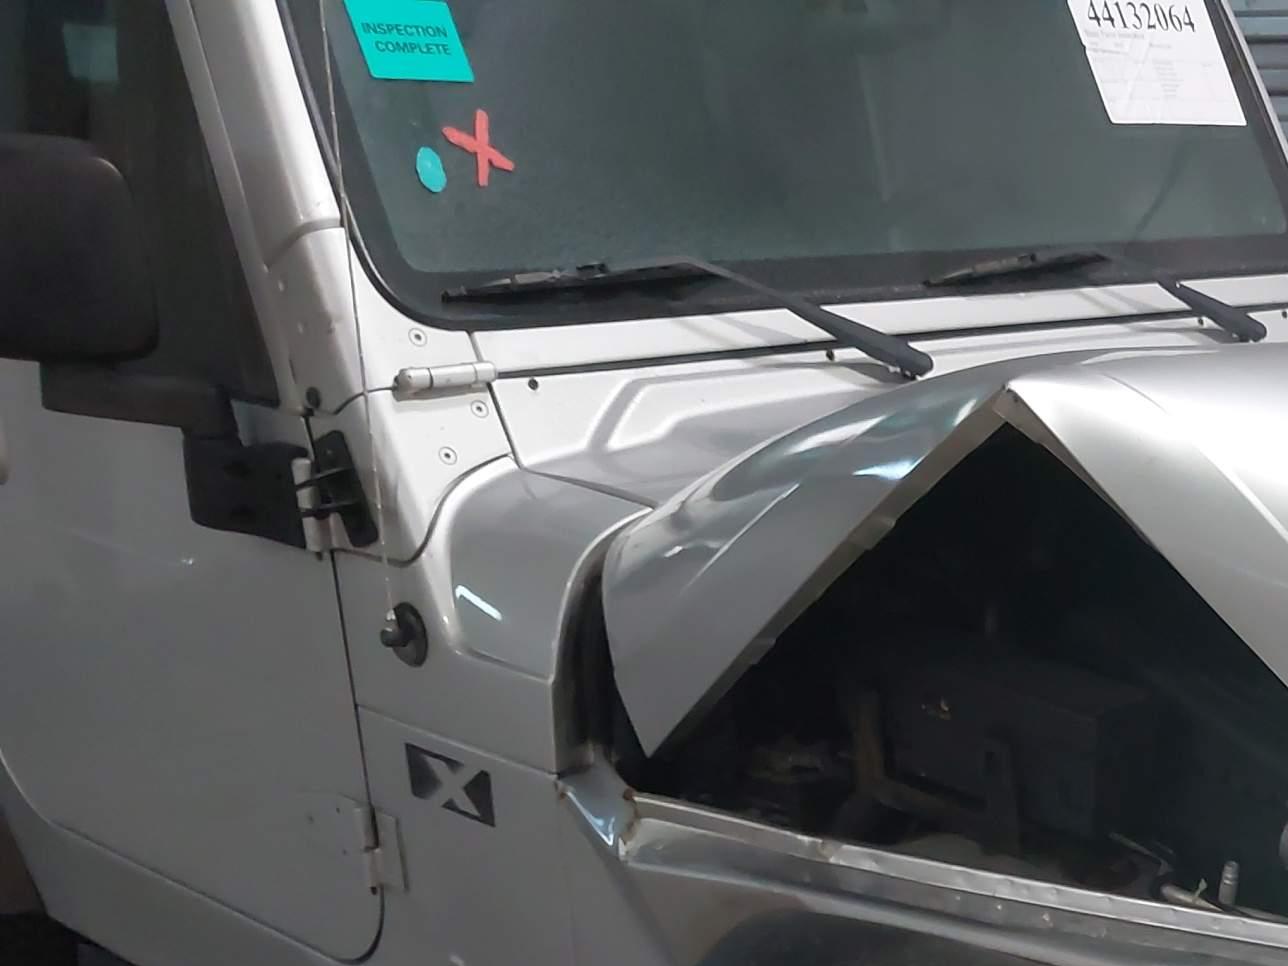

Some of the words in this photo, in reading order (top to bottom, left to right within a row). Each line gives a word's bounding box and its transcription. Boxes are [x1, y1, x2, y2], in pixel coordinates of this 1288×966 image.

[1087, 0, 1196, 33] 44132064
[361, 22, 449, 38] INSPECTION
[374, 40, 452, 56] COMPLETE
